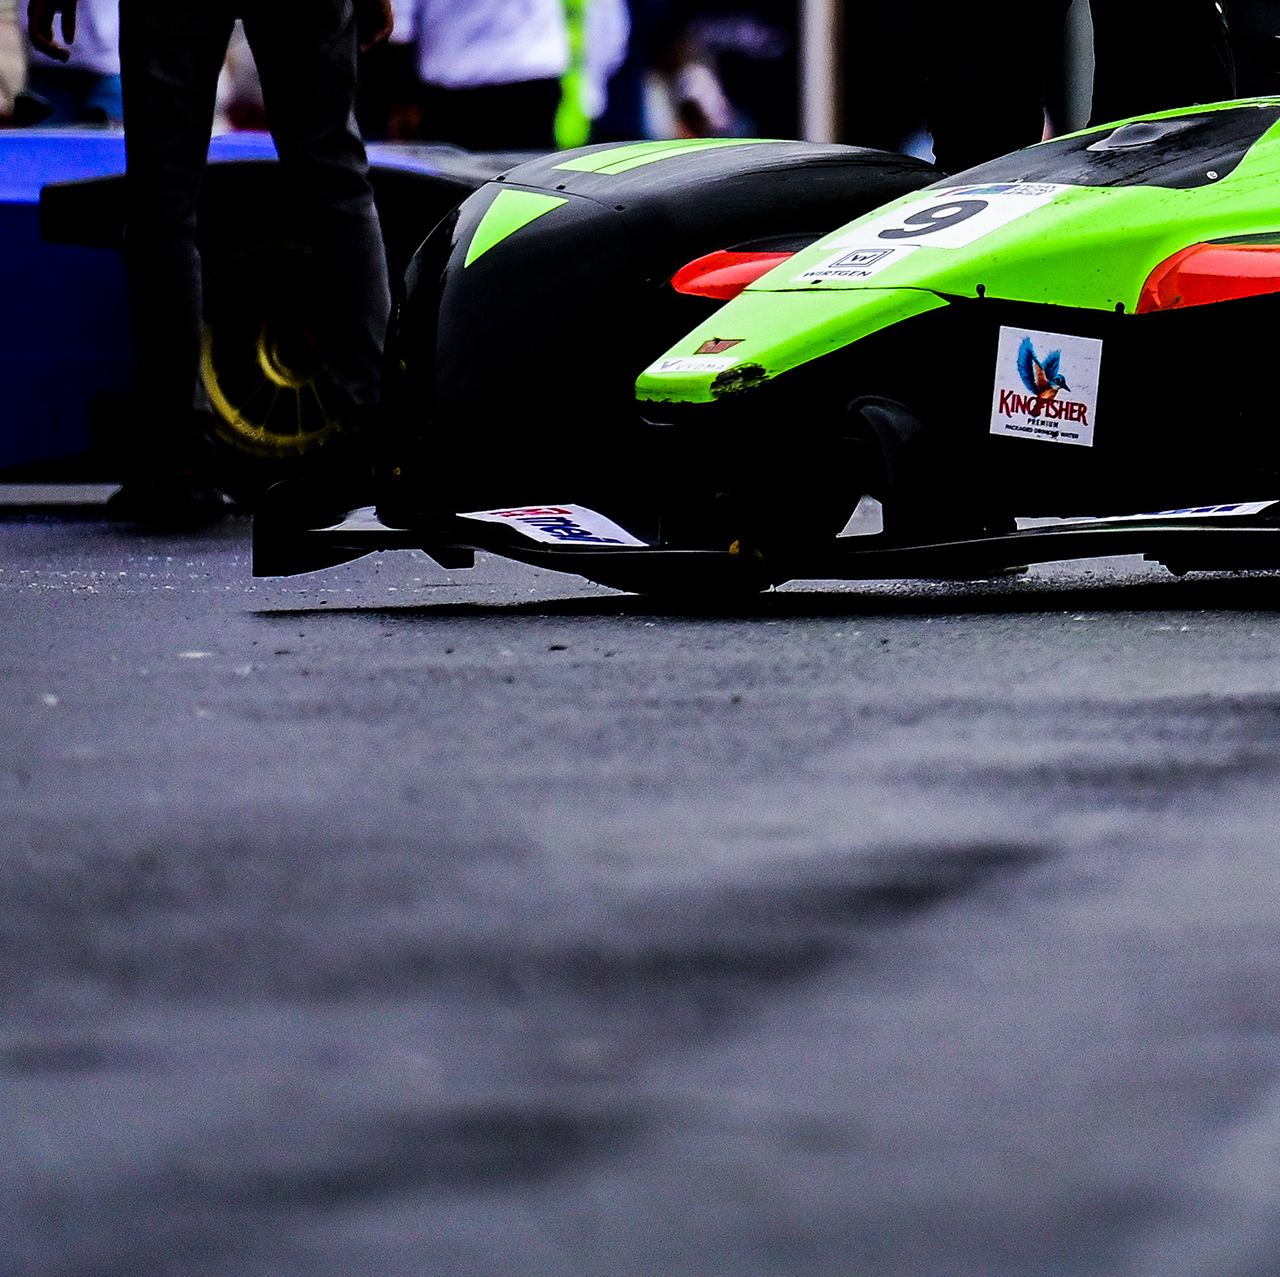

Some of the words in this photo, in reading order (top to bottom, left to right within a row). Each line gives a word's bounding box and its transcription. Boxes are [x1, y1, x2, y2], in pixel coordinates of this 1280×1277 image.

[877, 199, 989, 240] 9
[999, 388, 1089, 427] KINGFISHER
[1027, 417, 1059, 429] PREMIUM
